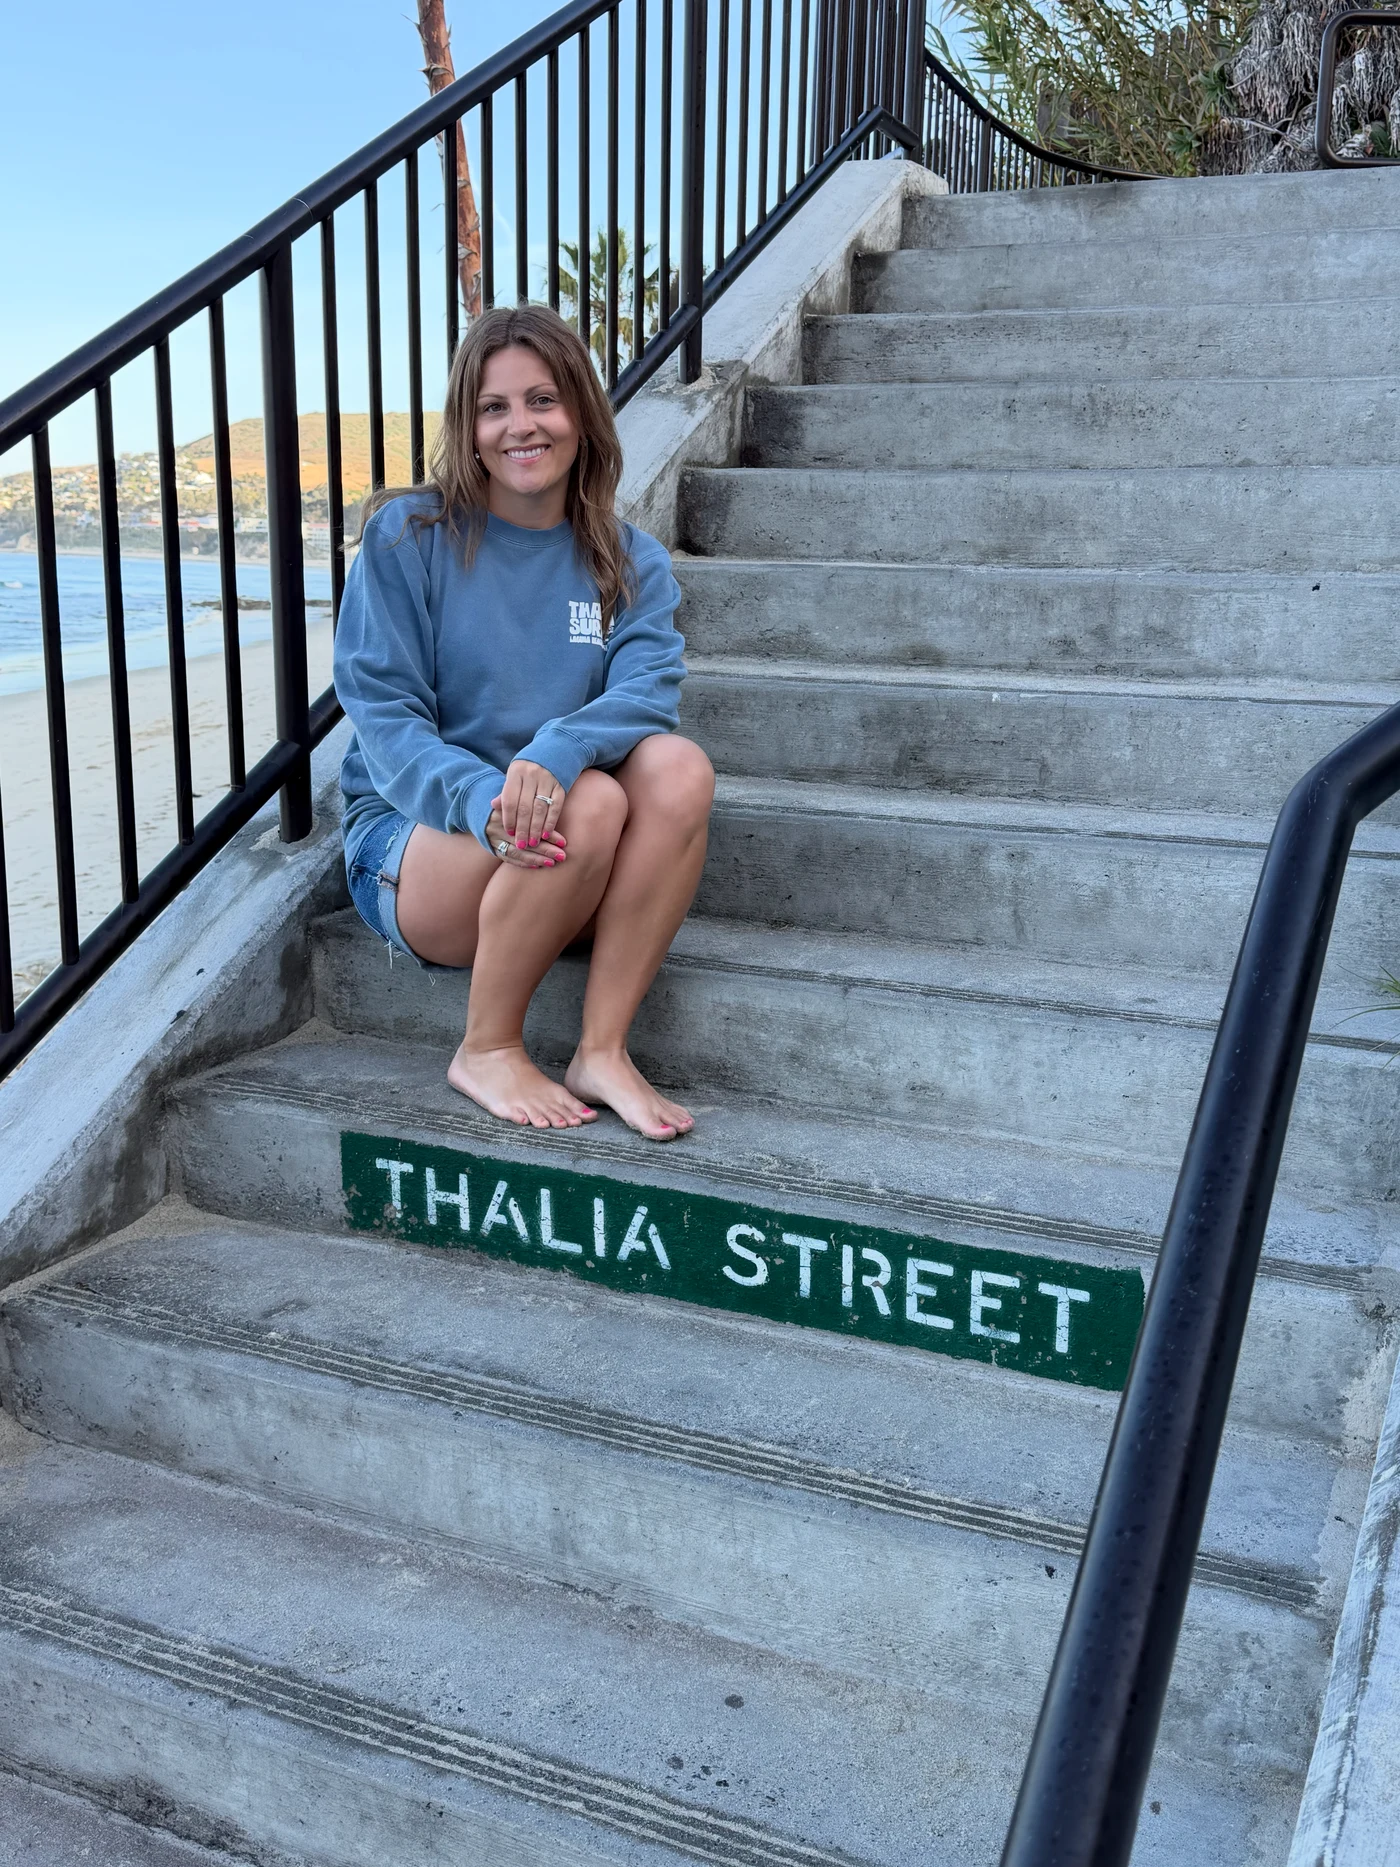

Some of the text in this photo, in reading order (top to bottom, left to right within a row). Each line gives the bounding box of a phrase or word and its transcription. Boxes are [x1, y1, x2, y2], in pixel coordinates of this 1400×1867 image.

[568, 600, 608, 621] THA
[569, 618, 607, 637] SUR
[375, 1157, 1091, 1353] THALIA STREET
